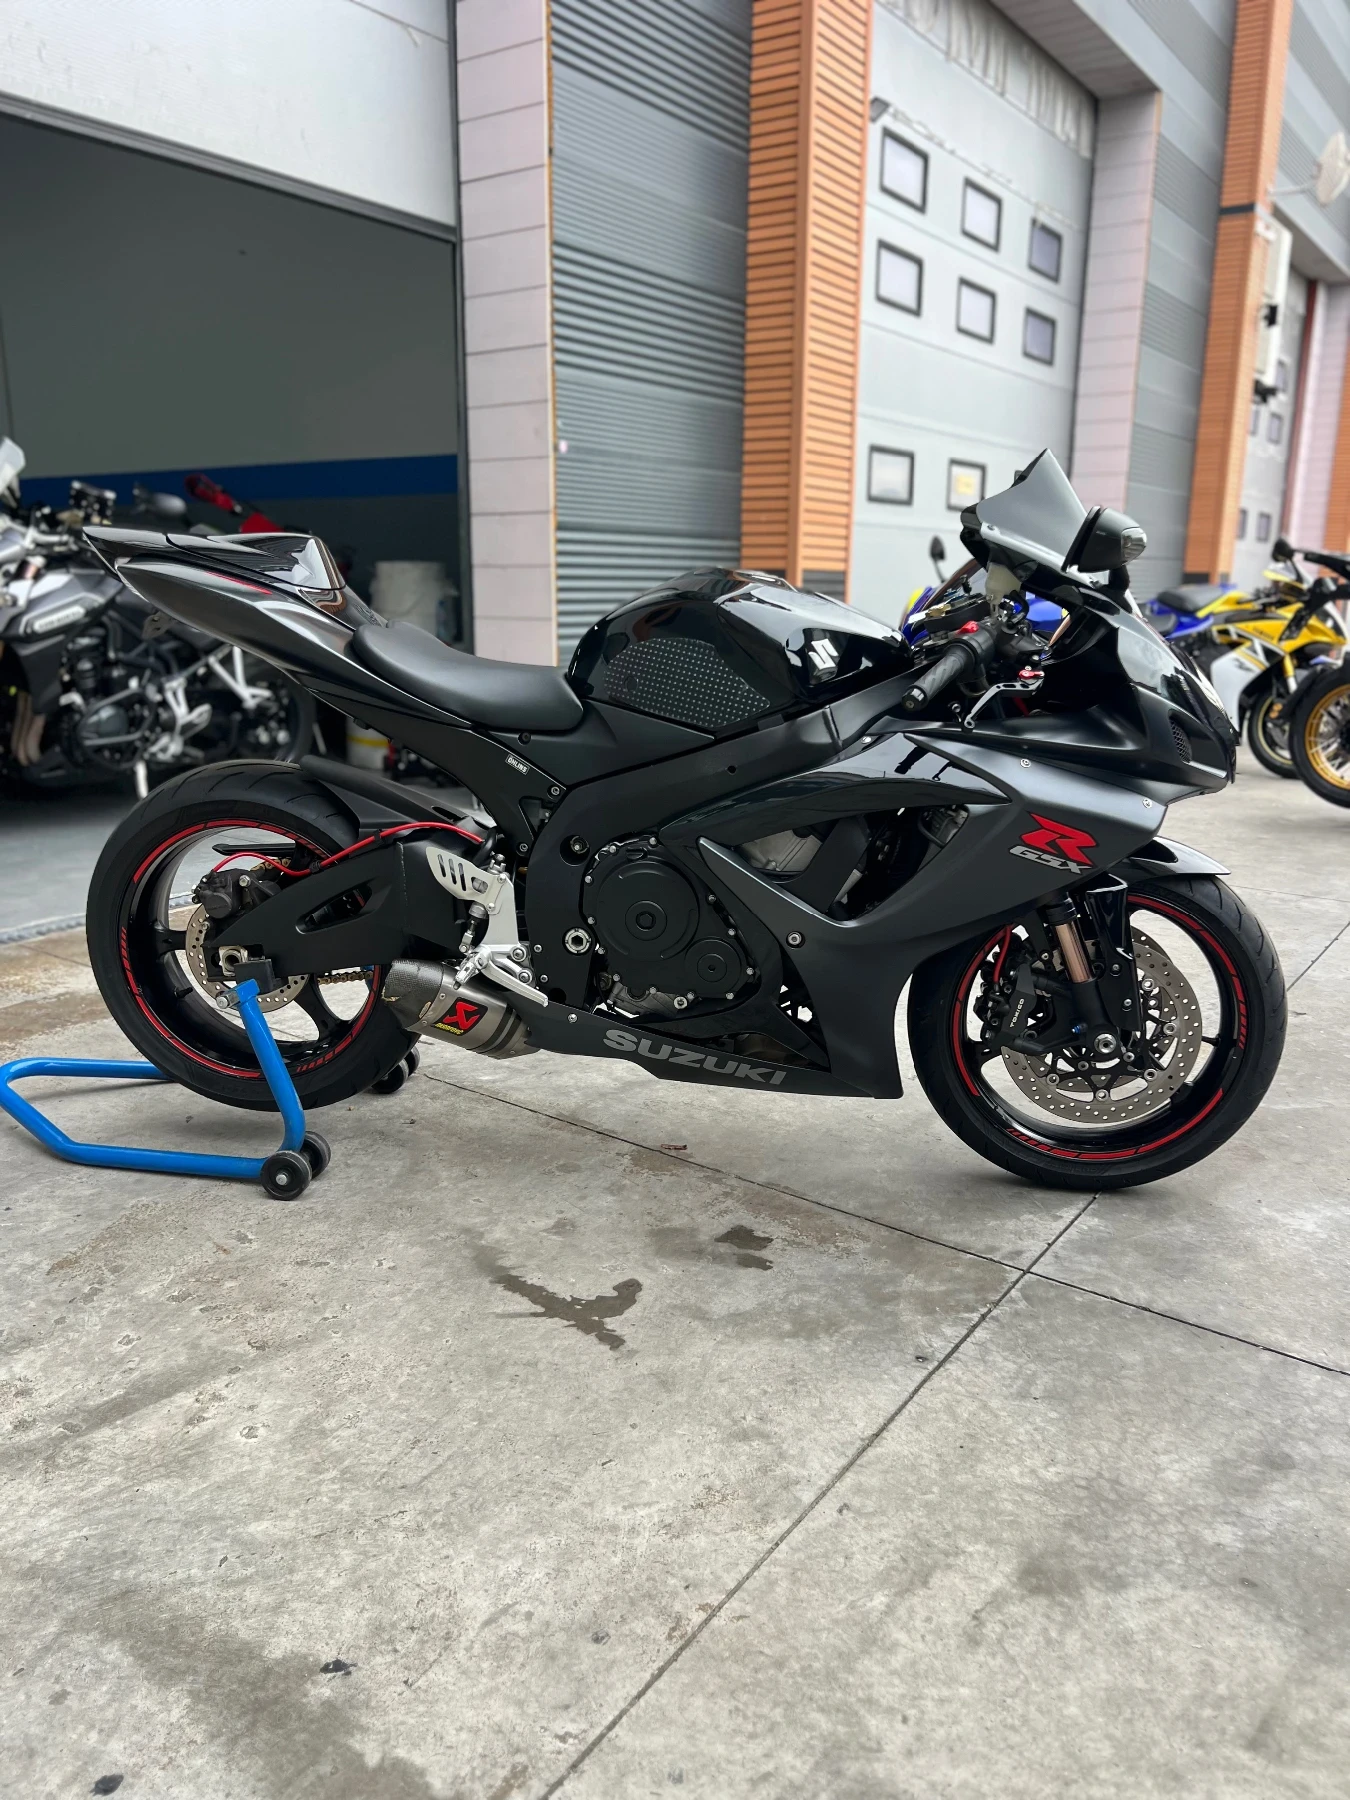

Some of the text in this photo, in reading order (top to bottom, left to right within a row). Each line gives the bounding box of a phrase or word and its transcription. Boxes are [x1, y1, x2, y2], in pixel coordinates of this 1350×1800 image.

[1009, 845, 1093, 874] GSX
[1009, 998, 1025, 1028] TOKICO
[603, 1029, 787, 1085] SUZUKI
